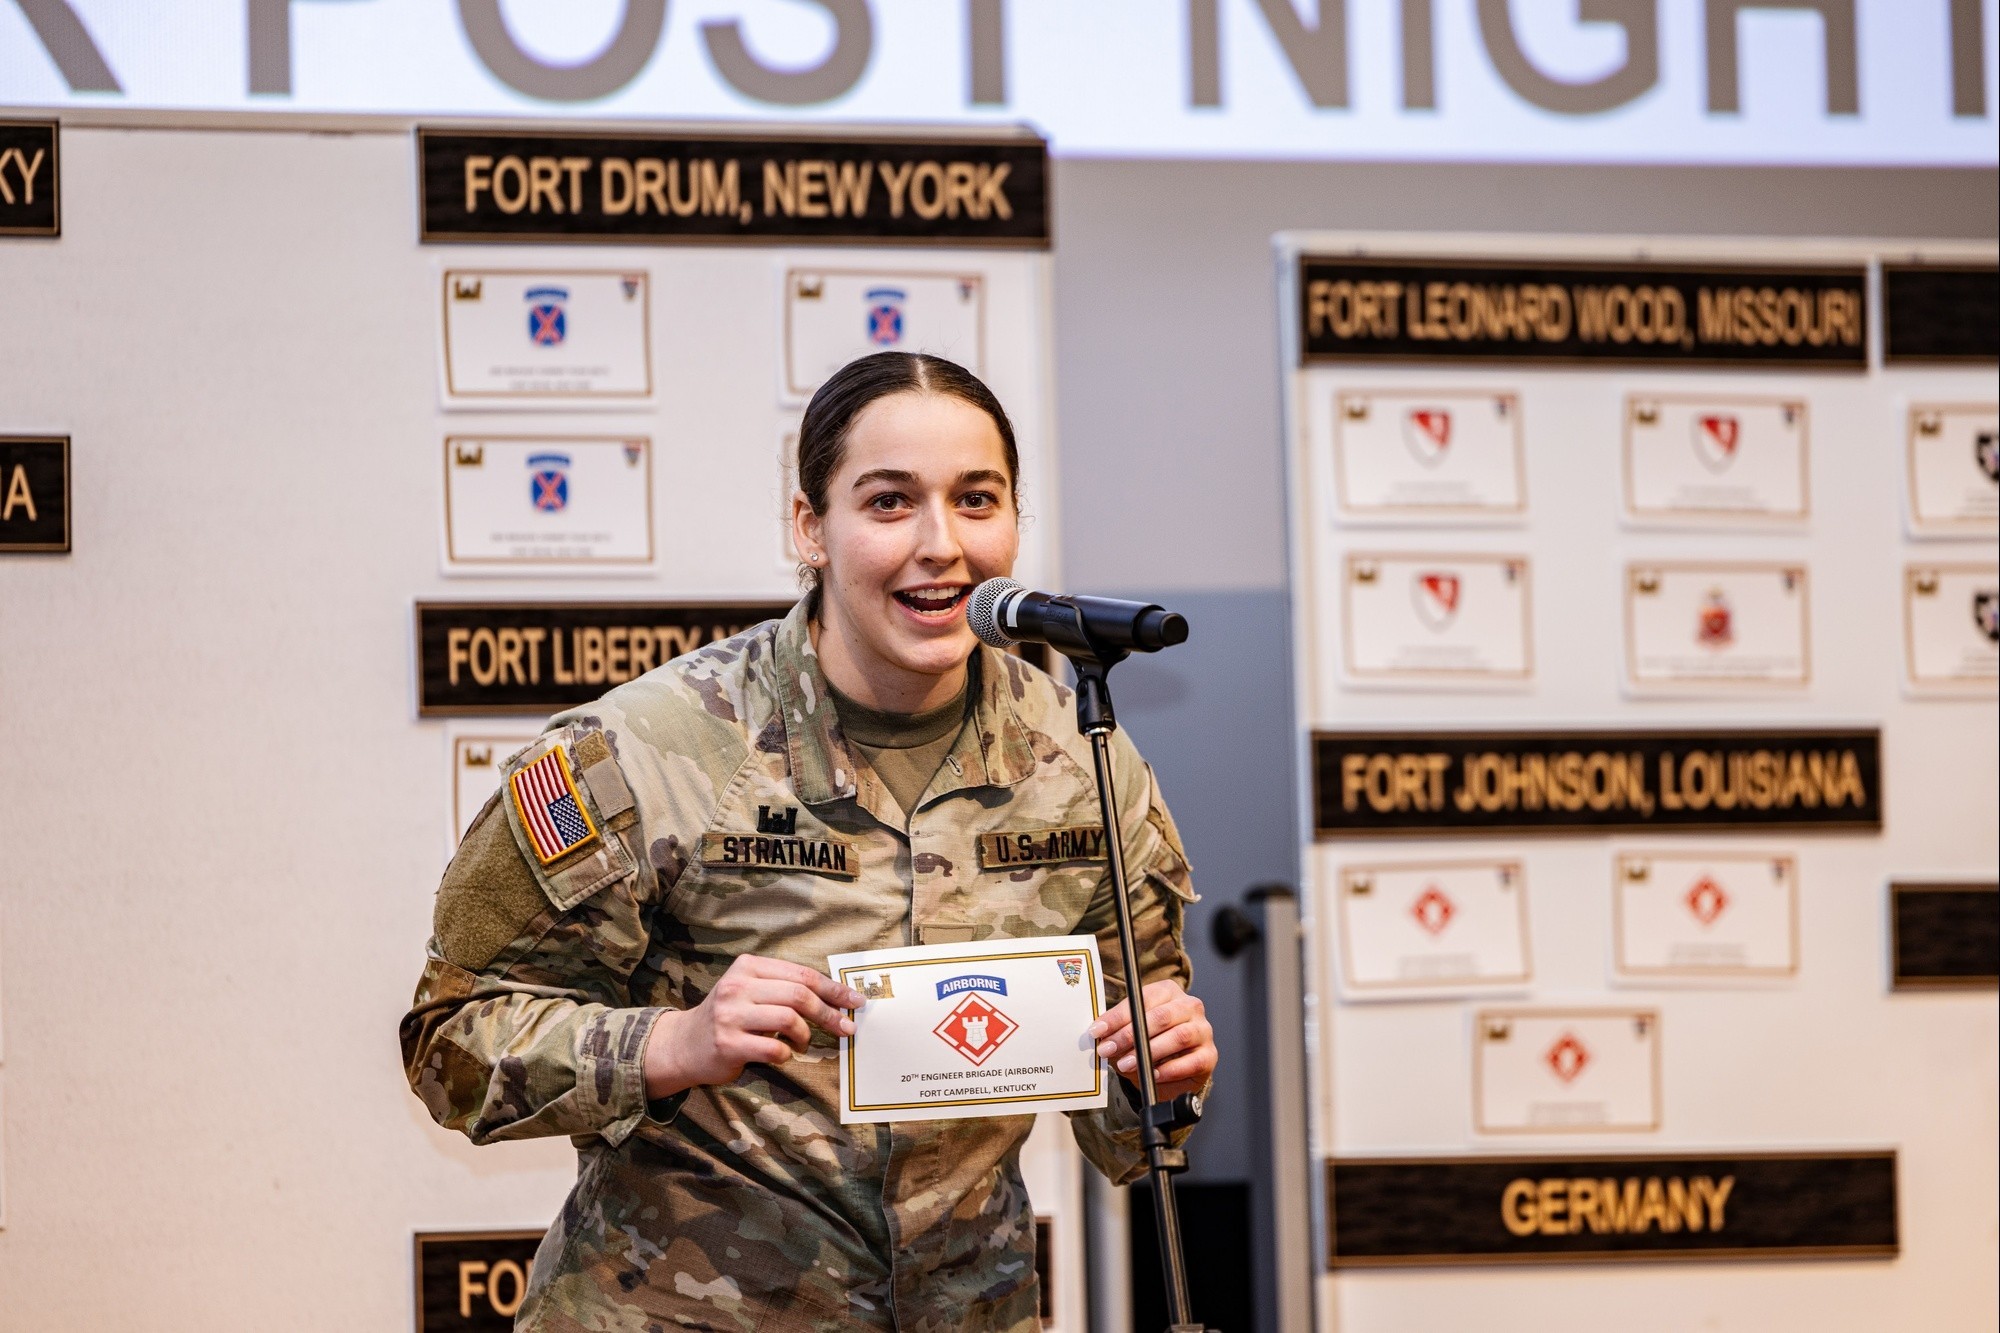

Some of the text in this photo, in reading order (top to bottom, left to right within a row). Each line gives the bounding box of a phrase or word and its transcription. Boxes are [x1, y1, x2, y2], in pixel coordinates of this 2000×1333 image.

[464, 155, 1012, 223] FORT DRUM, NEW YORK
[1308, 279, 1861, 347] FORT LEONARD WOOD, MISSOURI
[447, 627, 547, 686] FORT
[1341, 750, 1866, 815] FORT JOHNSON, LOUISIANA
[723, 836, 847, 871] STRATMAN
[995, 829, 1104, 863] U.S. ARMY
[942, 977, 1001, 995] AIRBORNE
[900, 1065, 1054, 1083] 20TH ENGINEER BRIGADE (AIRBORNE)
[919, 1083, 1038, 1098] FORT CAMPBELL, KENTUCKY
[1500, 1175, 1735, 1237] GERMANY
[459, 1259, 534, 1318] FO
